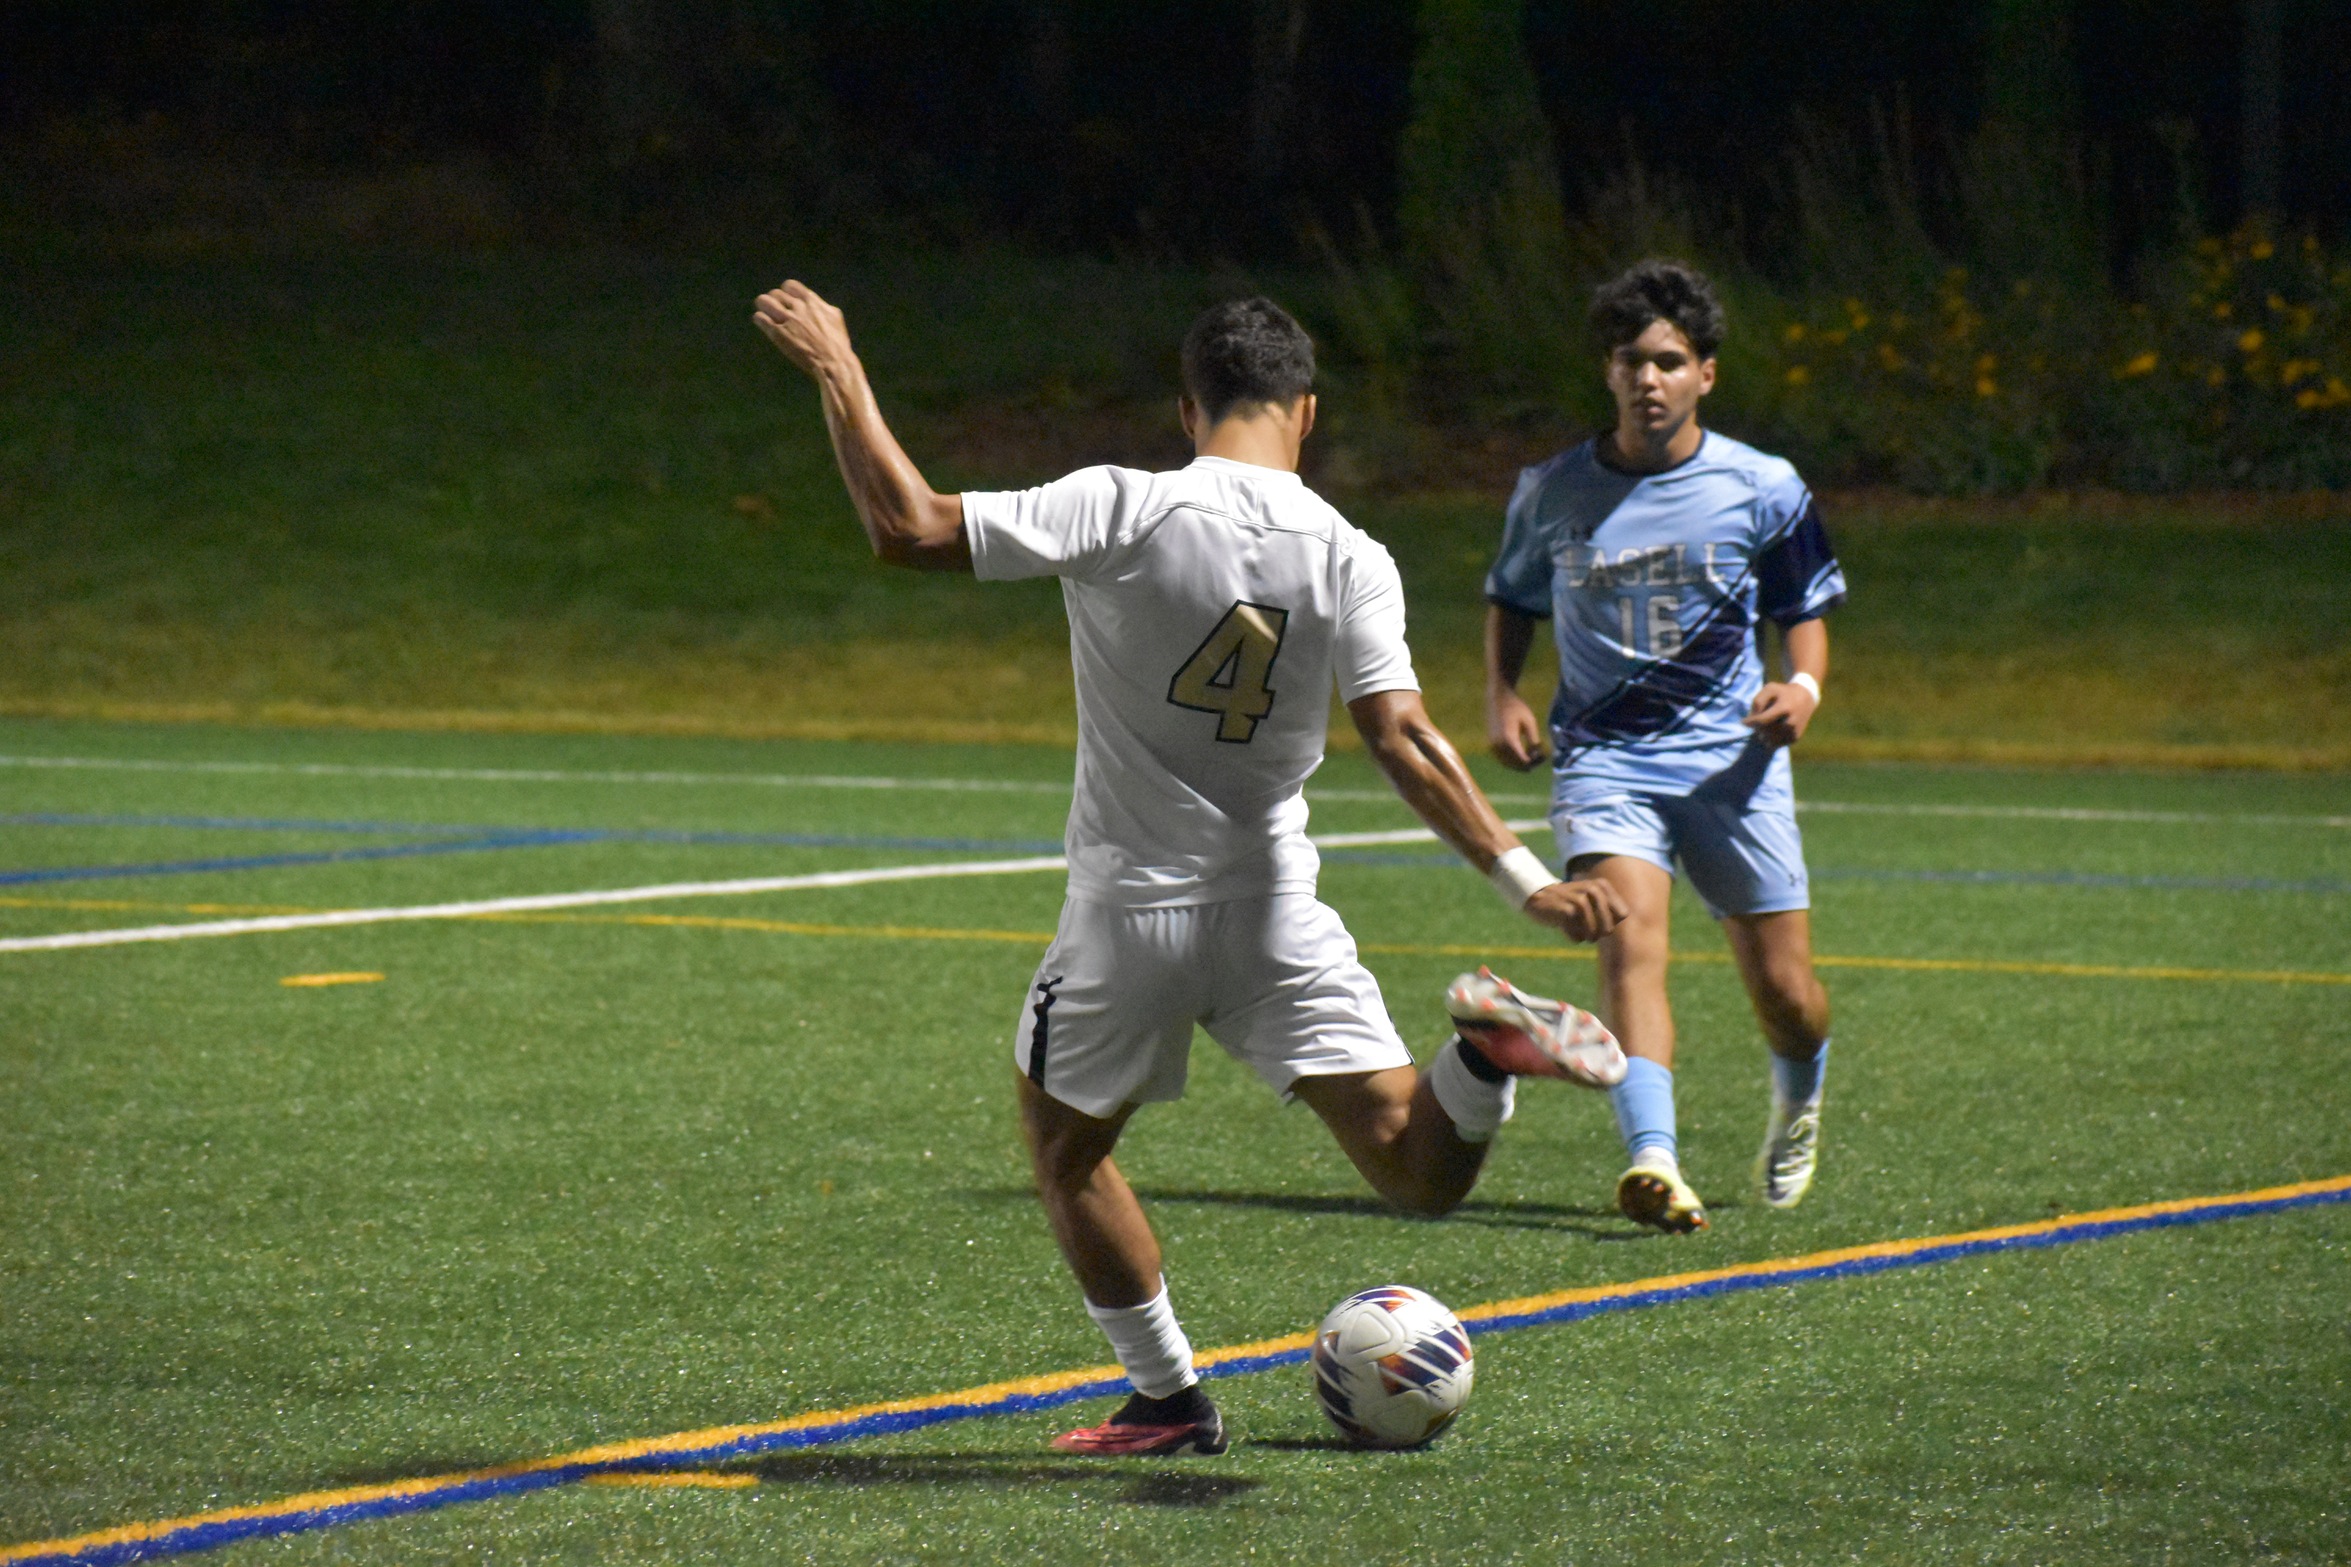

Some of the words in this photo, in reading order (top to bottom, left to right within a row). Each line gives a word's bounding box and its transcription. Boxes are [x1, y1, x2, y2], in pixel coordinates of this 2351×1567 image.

[1564, 542, 1726, 588] LASELL
[1619, 595, 1683, 659] 16
[1166, 599, 1289, 744] 4
